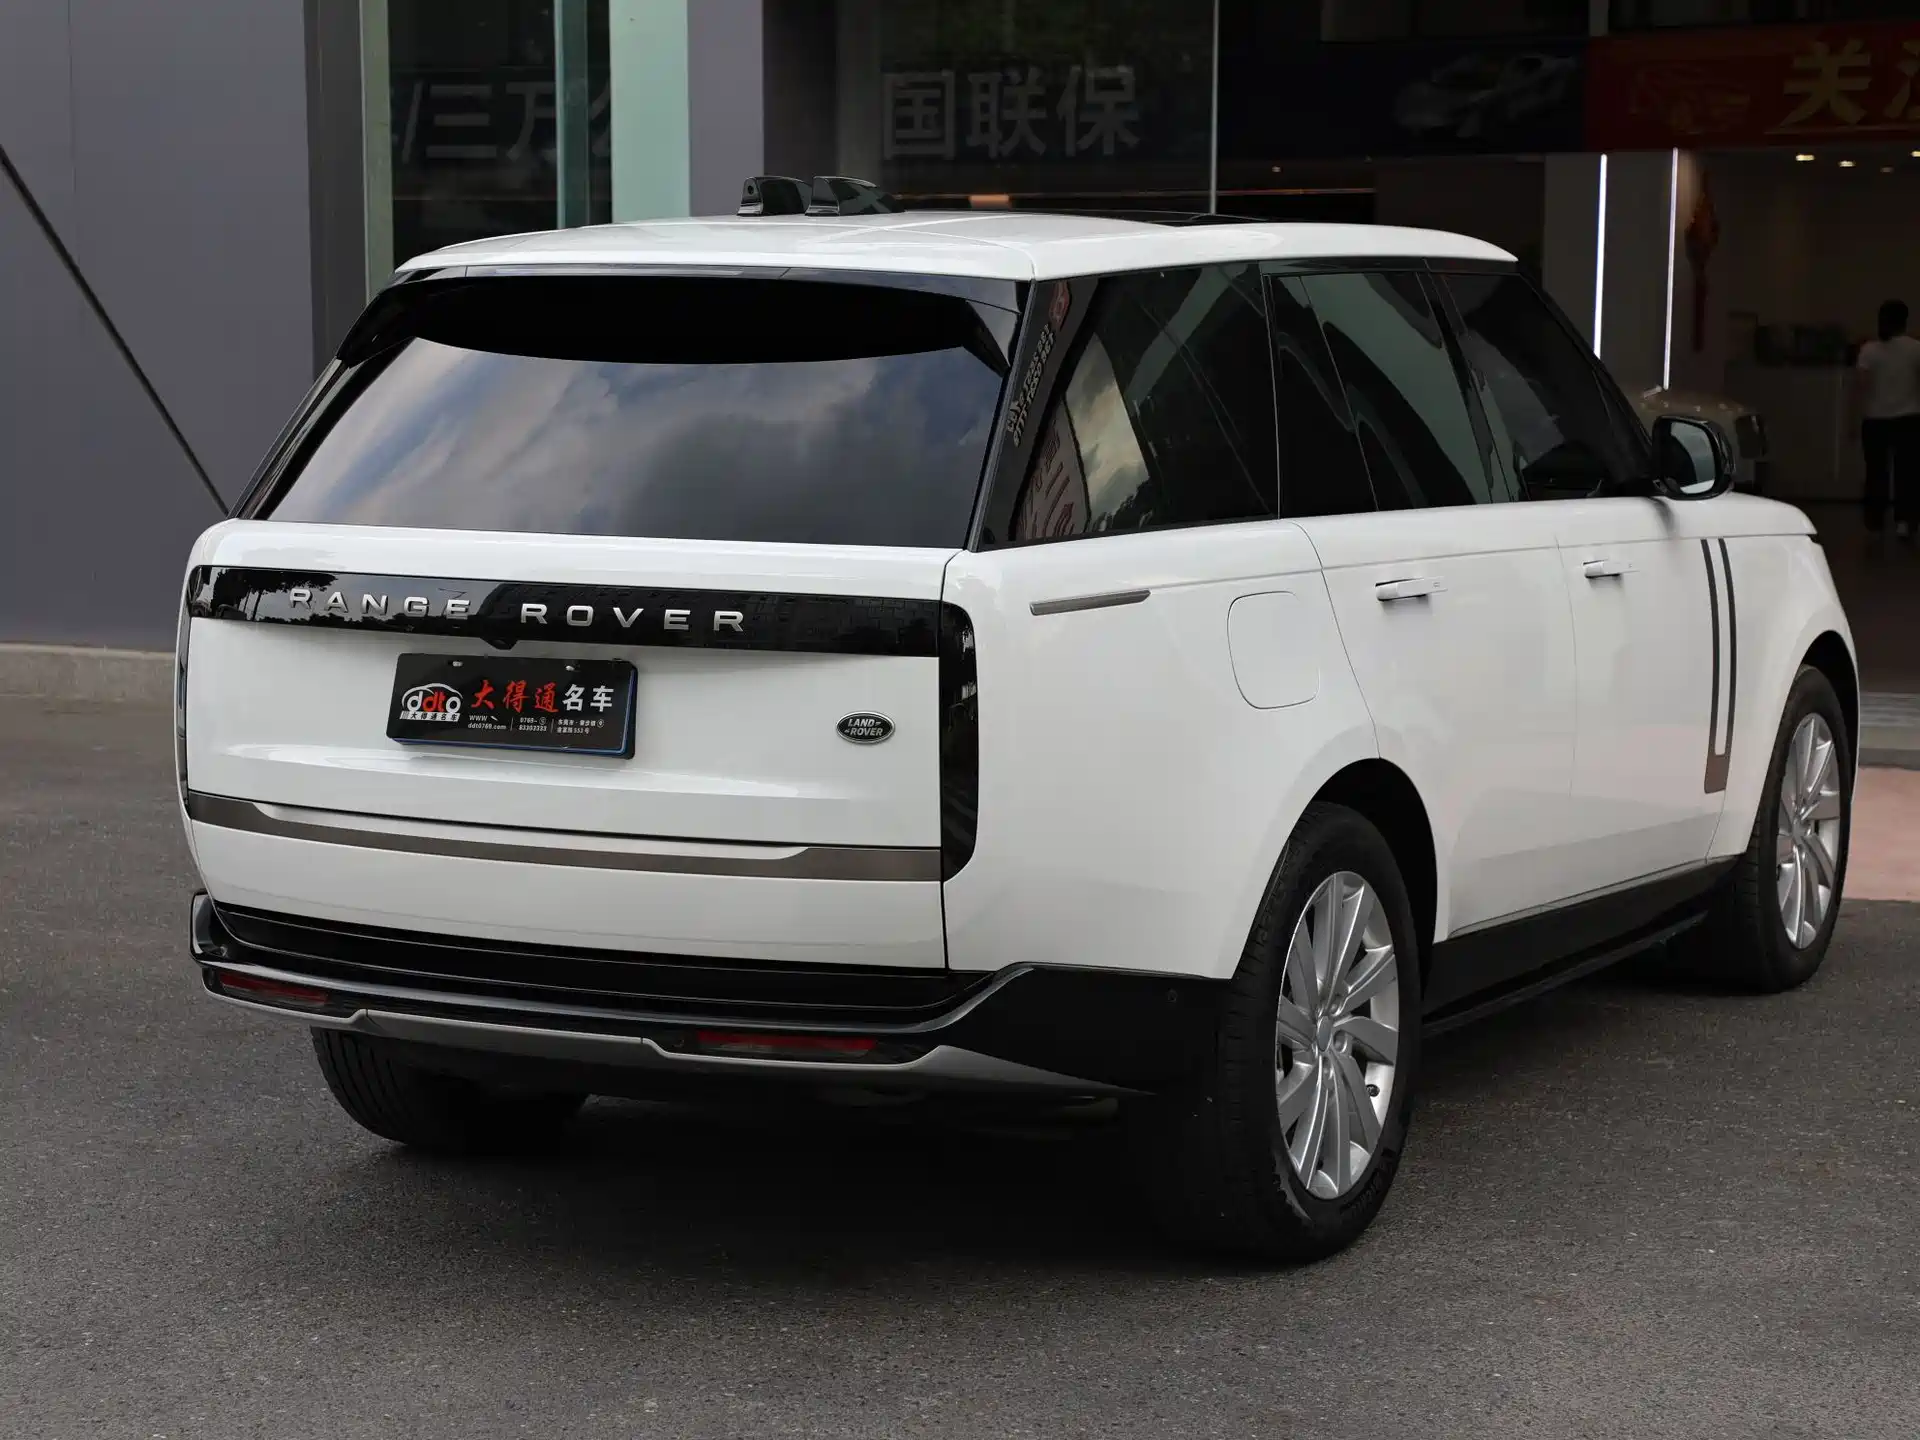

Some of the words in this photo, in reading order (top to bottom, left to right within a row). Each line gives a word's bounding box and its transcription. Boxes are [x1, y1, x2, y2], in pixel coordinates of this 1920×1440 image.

[884, 65, 1141, 161] 国联保
[289, 587, 471, 620] RANGE
[520, 603, 744, 632] ROVER
[847, 718, 875, 727] LAND
[849, 727, 883, 736] ROVER
